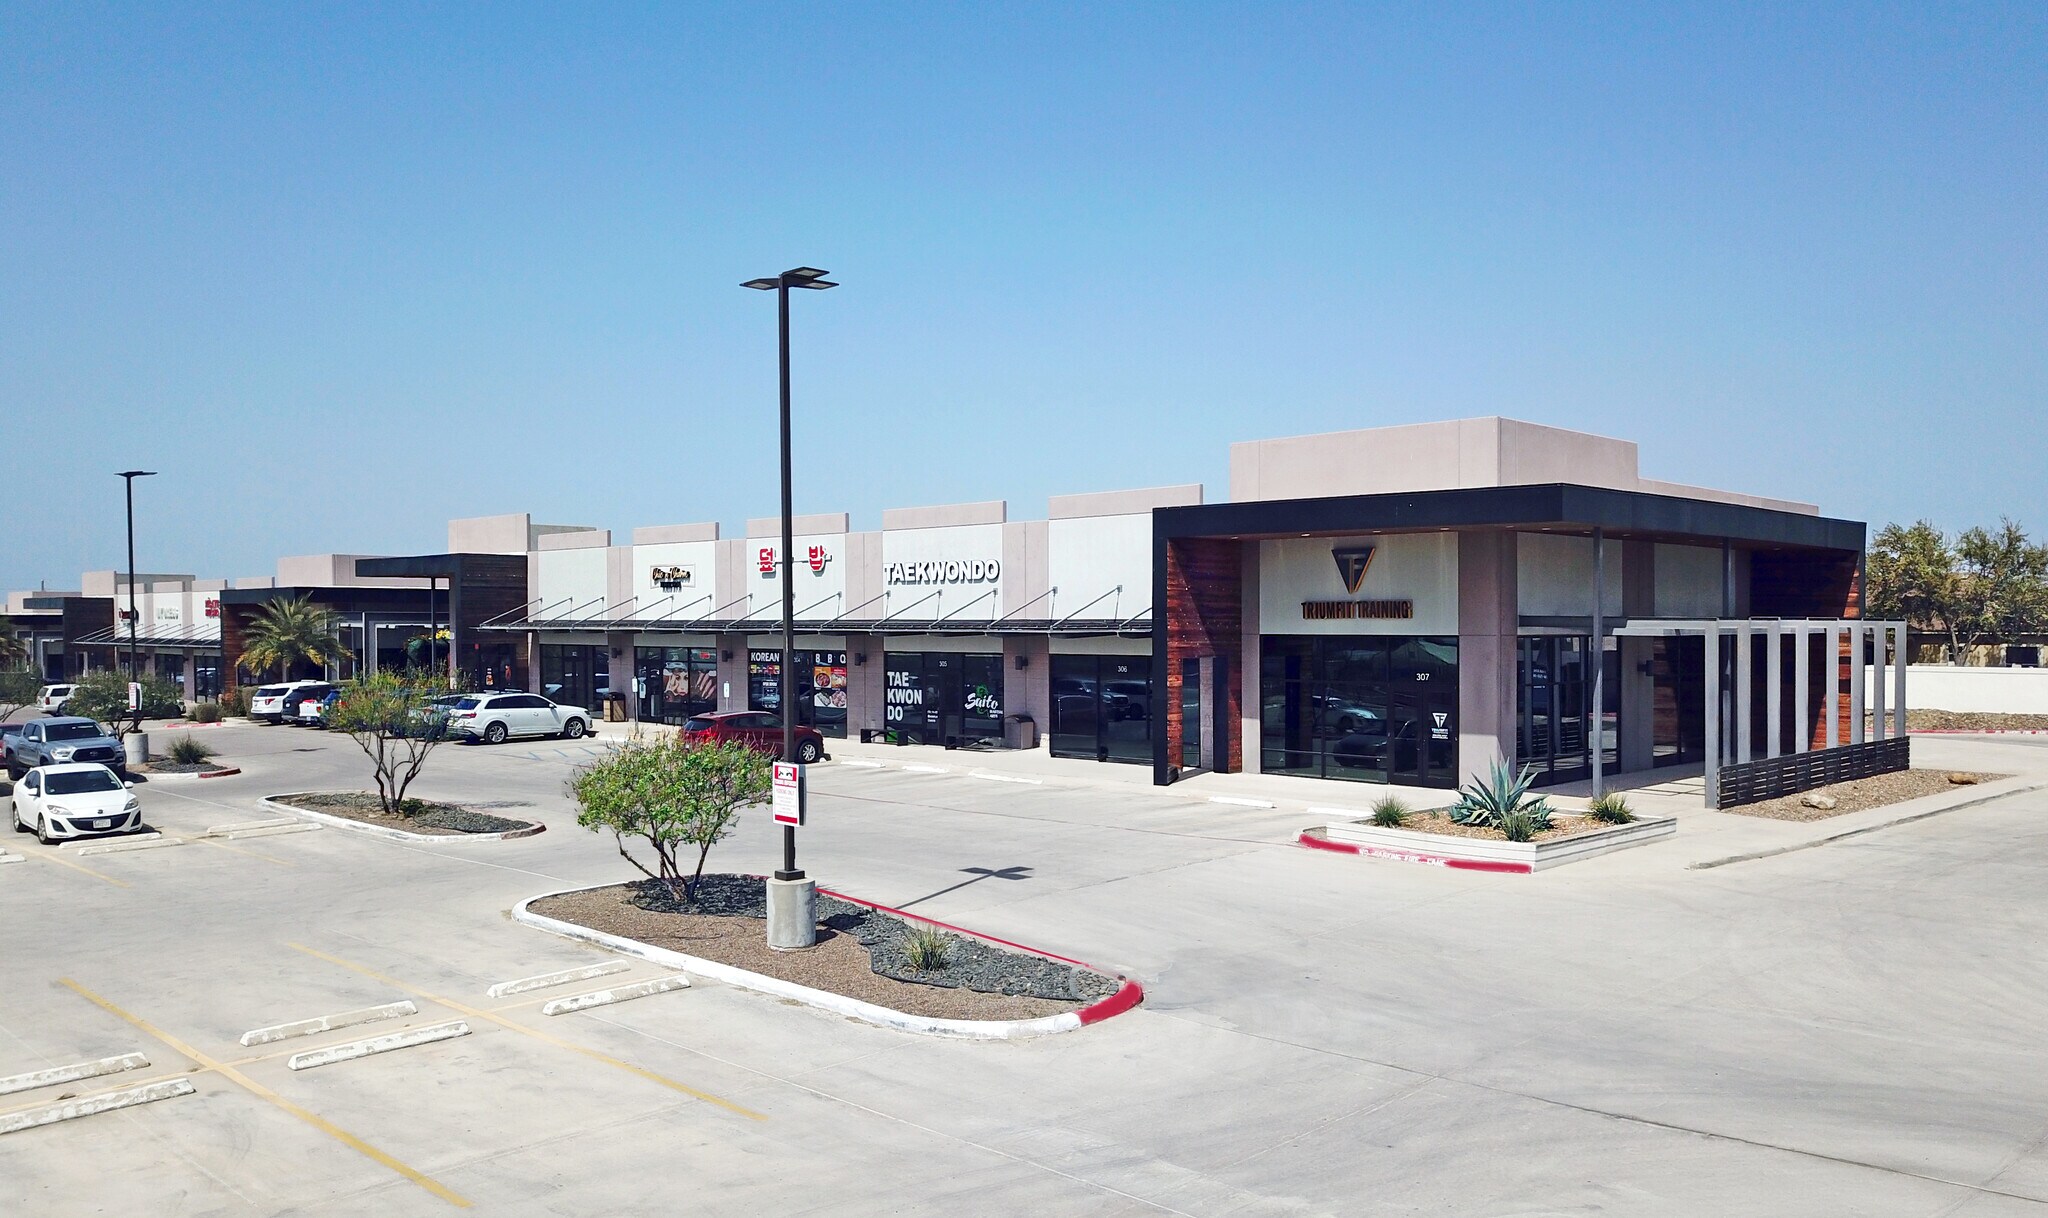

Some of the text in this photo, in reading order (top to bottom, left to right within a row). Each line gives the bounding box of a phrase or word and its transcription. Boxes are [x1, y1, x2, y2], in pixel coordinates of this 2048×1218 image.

[883, 560, 1000, 583] TAEKWONDO
[1301, 600, 1411, 619] TRIUMFIT TRAINING
[750, 652, 780, 662] KOREAN
[1117, 665, 1128, 673] 306
[1416, 673, 1430, 681] 307
[887, 671, 910, 687] TAE
[887, 688, 922, 704] KWON
[887, 705, 904, 721] DO
